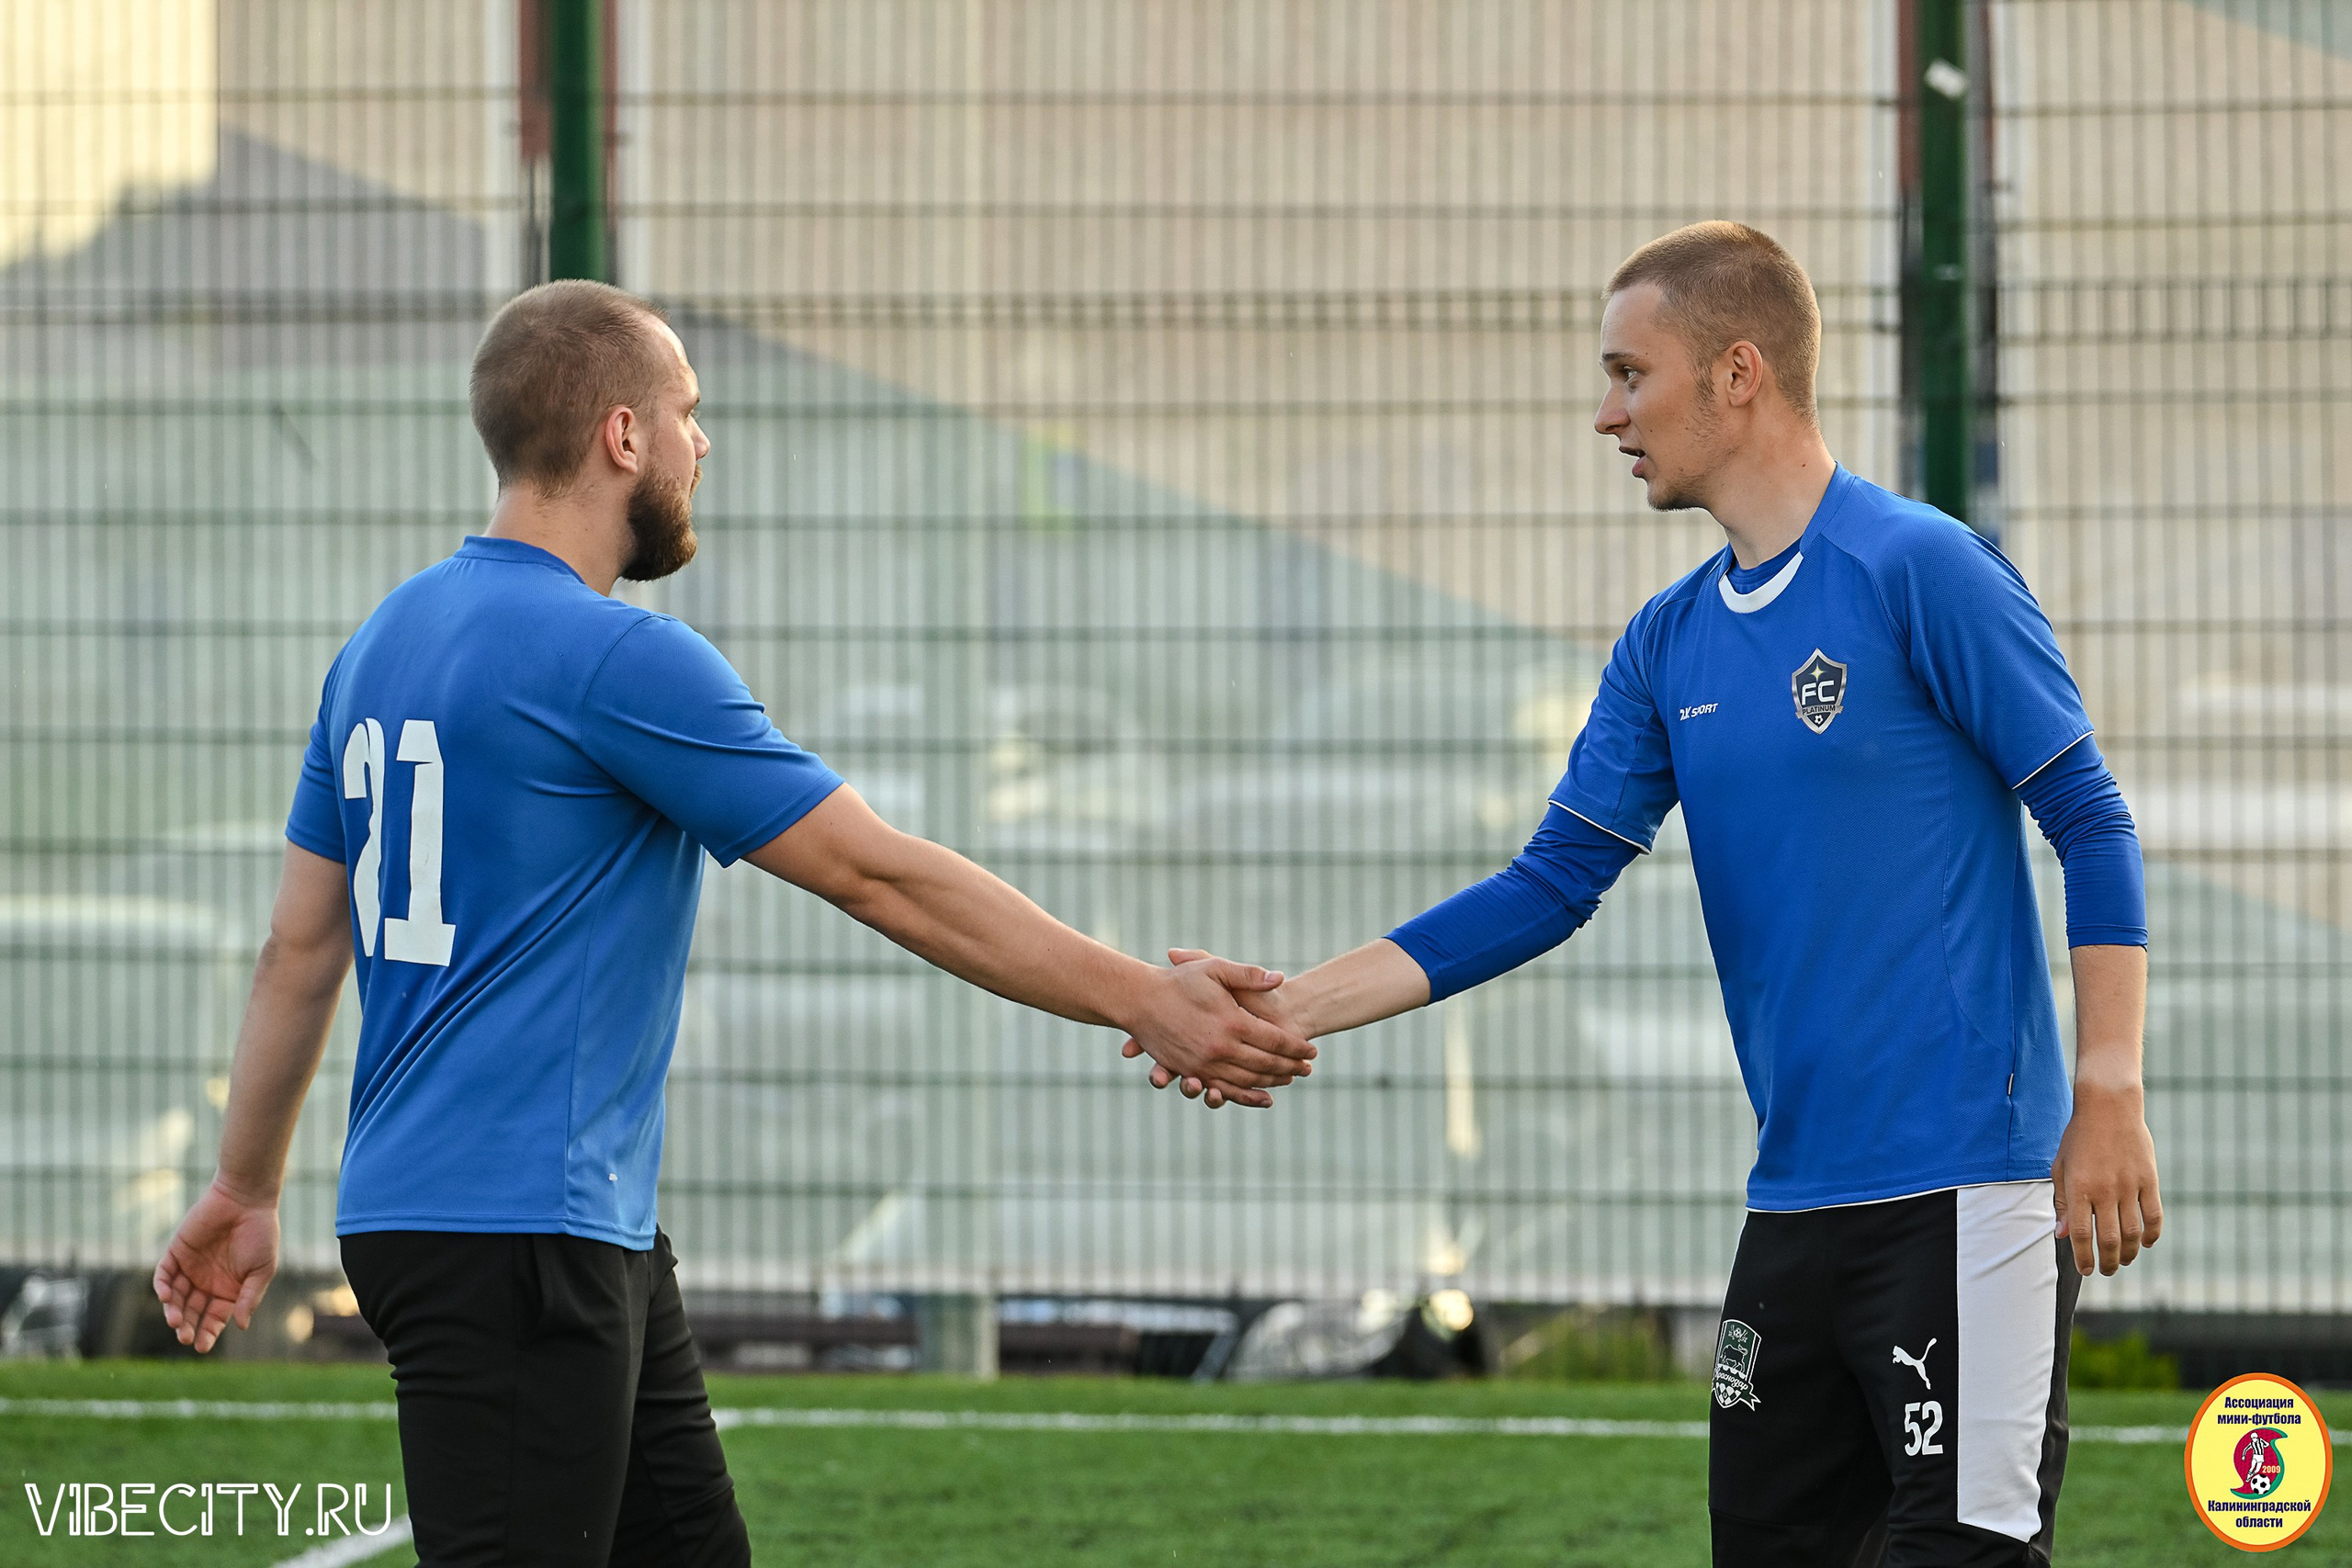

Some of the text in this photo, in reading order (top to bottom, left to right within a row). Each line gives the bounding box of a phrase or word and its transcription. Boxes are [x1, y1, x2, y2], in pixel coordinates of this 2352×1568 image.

[1802, 681, 1835, 705] FC
[1802, 705, 1836, 715] PLATINUM
[344, 717, 456, 967] 21
[1905, 1401, 1943, 1456] 52
